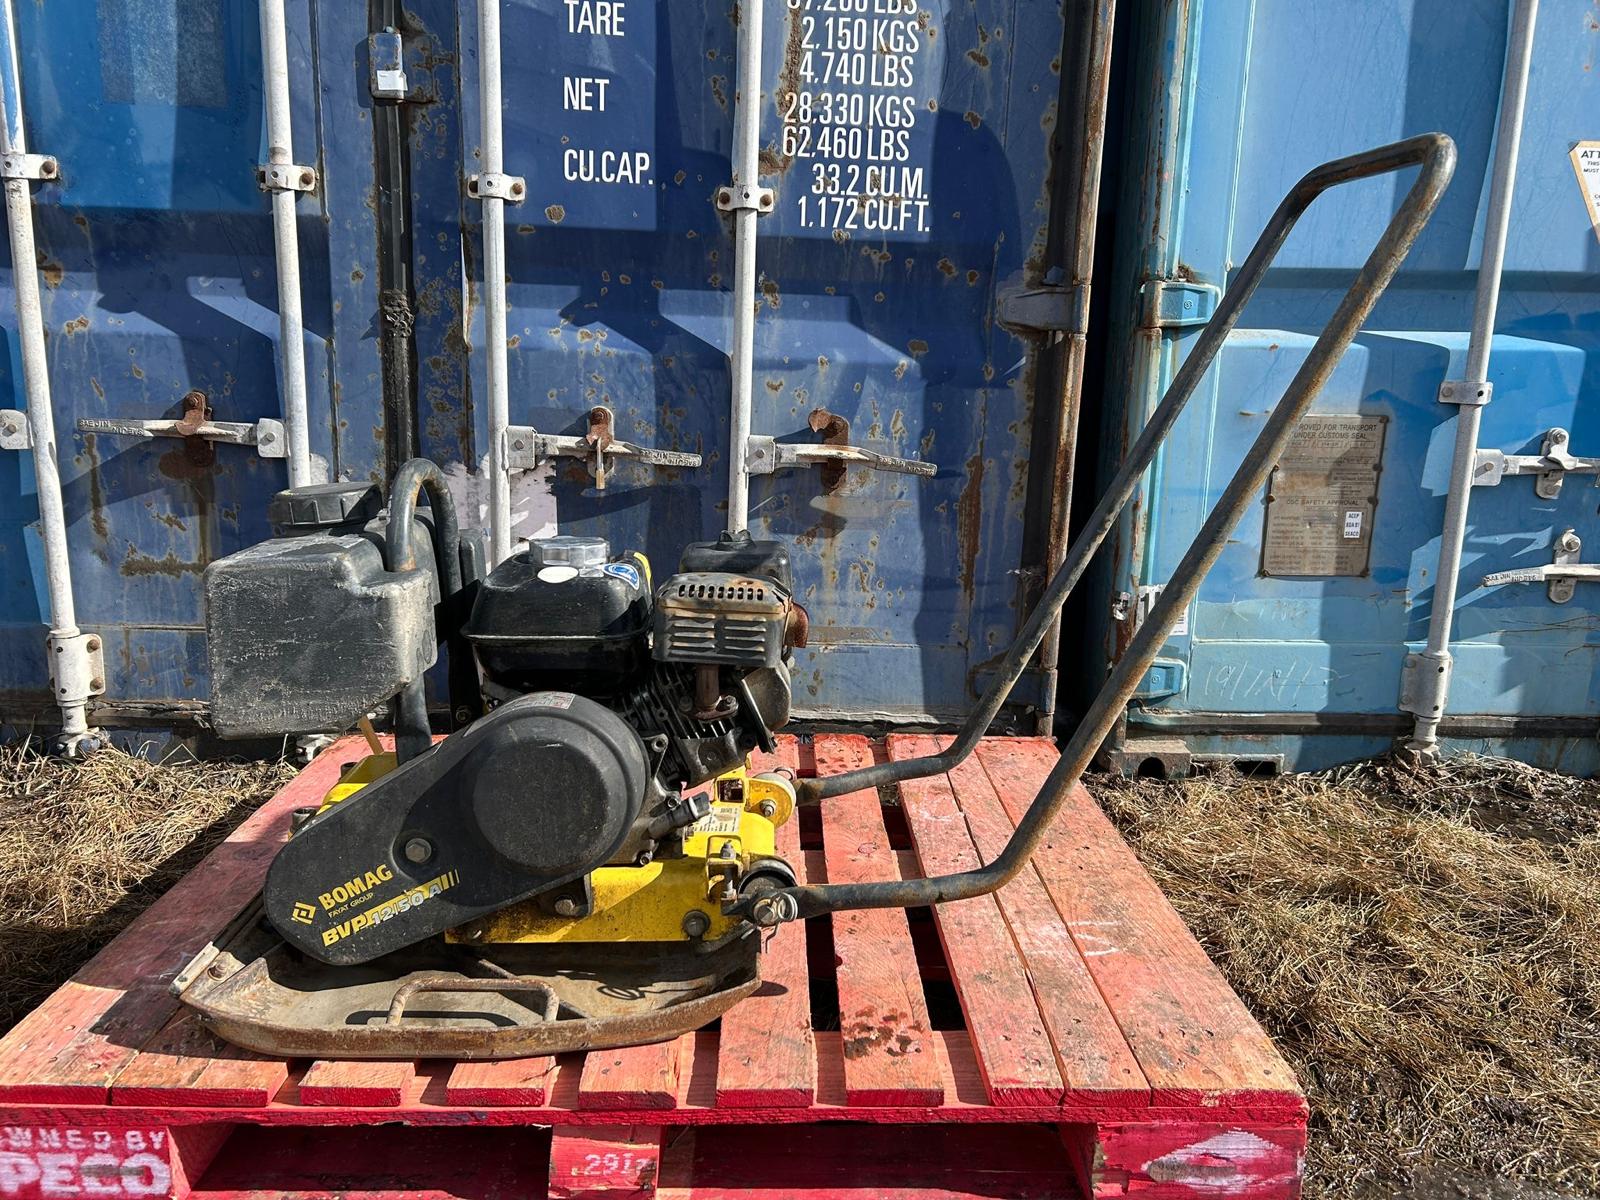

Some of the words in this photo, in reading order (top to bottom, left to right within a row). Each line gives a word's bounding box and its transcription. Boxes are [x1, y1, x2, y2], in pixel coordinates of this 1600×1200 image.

[563, 0, 625, 37] TARE
[801, 16, 868, 51] 2,150
[872, 19, 920, 53] KGS
[800, 51, 866, 85] 4,740
[870, 54, 914, 88] LBS
[563, 76, 610, 112] NET
[784, 92, 863, 126] 28,330
[869, 94, 916, 128] KGS
[782, 125, 862, 160] 62,460
[867, 128, 910, 162] LBS
[563, 149, 654, 185] CU.CAP.
[811, 162, 860, 196] 33.2
[865, 165, 928, 200] CU.M.
[797, 195, 859, 230] 1,172
[864, 199, 930, 233] CU.FT.
[1293, 431, 1316, 439] UNDER
[1318, 432, 1350, 440] CUSTOMS
[318, 864, 393, 911] BOMAG
[328, 903, 349, 919] FAYAT
[349, 892, 374, 908] GROUP
[322, 914, 368, 947] BVP
[0, 1127, 113, 1150] WNED
[125, 1130, 165, 1150] BY
[0, 1152, 173, 1195] PECO
